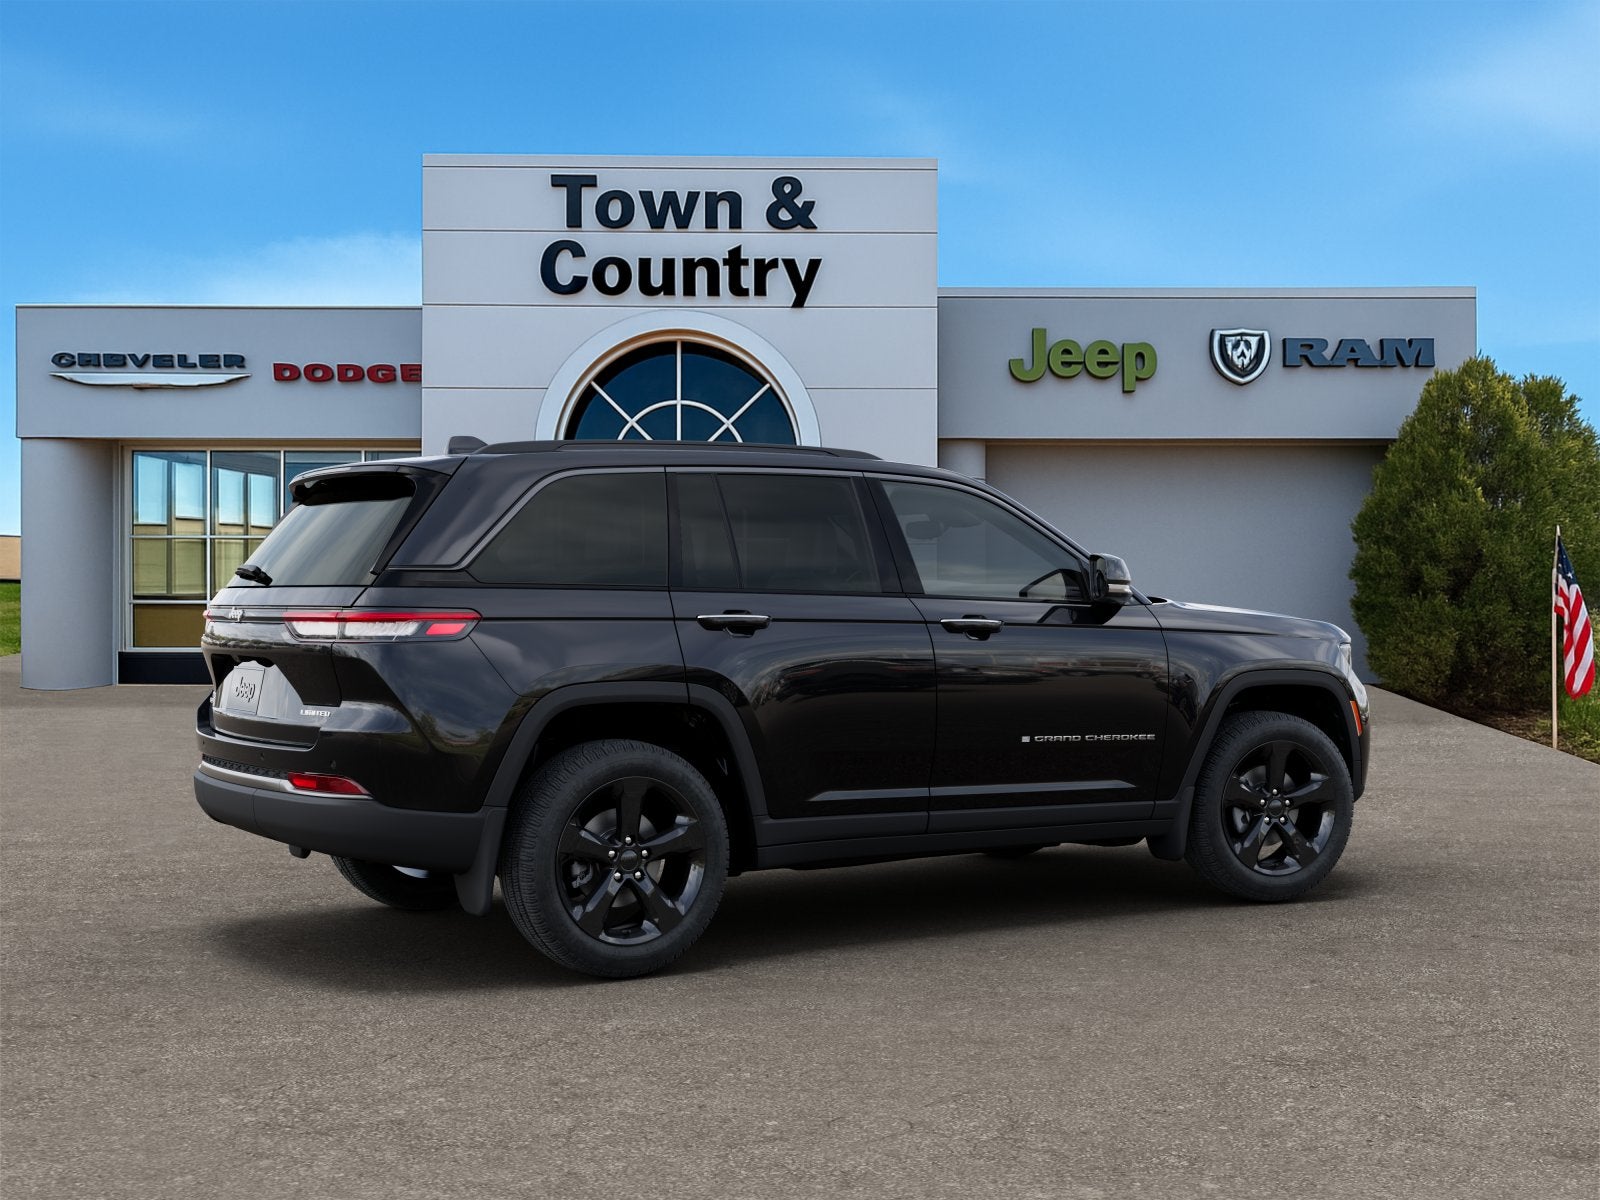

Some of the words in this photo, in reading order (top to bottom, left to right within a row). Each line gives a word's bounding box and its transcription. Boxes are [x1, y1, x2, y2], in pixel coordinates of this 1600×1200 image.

[551, 174, 742, 229] Town
[766, 175, 818, 229] &
[540, 240, 821, 308] Country
[273, 363, 422, 383] DODGE
[1009, 328, 1157, 393] Jeep
[1283, 337, 1435, 367] RAM
[1085, 733, 1156, 741] CHEROKEE
